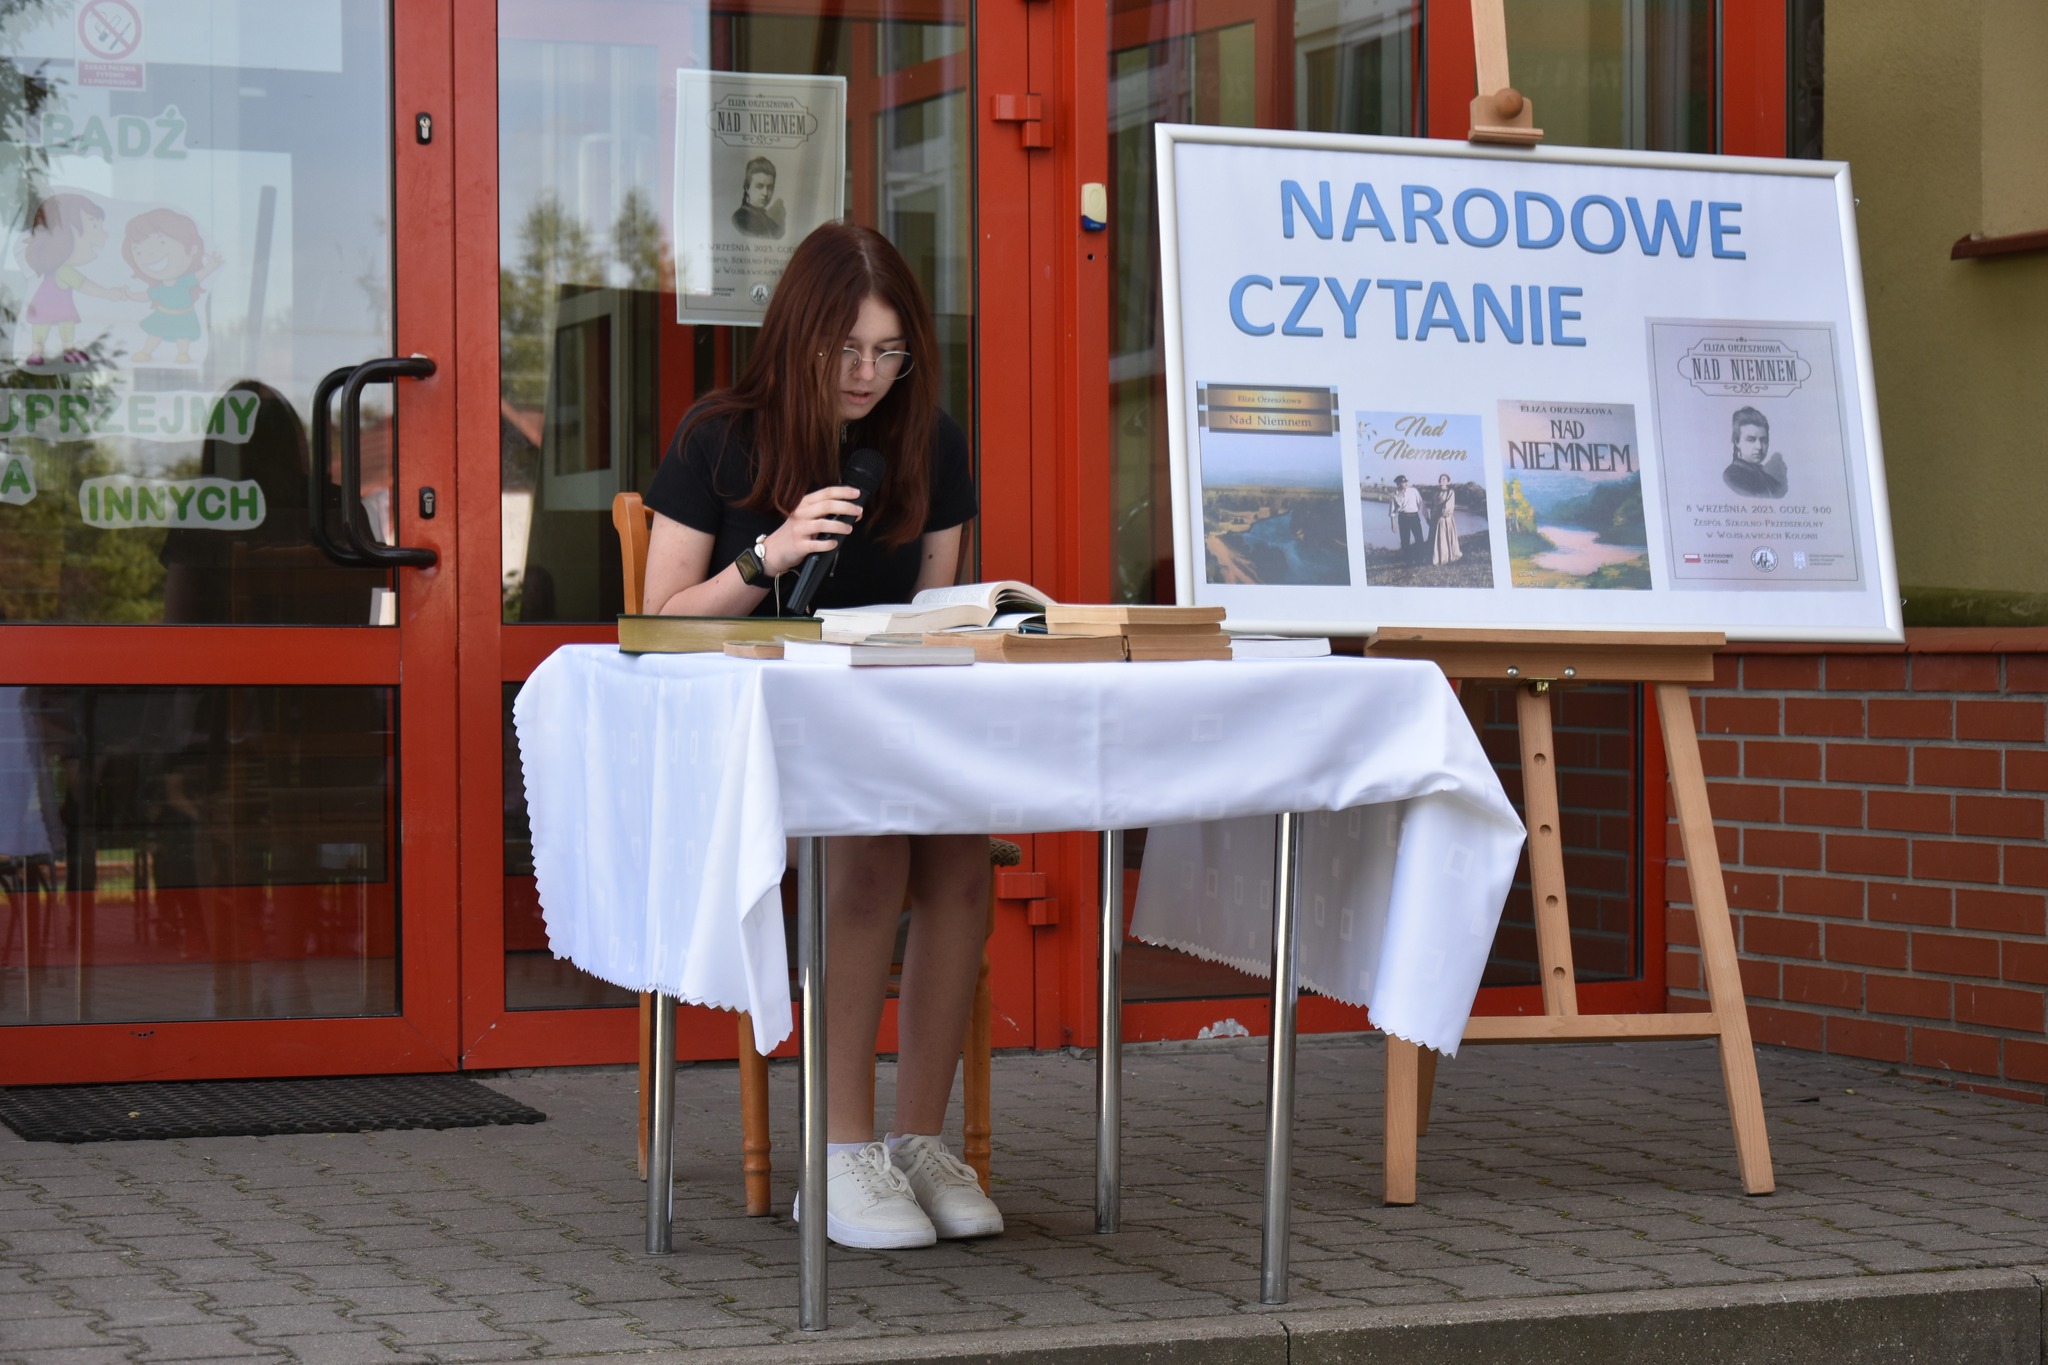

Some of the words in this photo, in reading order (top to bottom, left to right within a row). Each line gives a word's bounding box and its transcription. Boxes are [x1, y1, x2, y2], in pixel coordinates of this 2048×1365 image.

[728, 98, 747, 107] ELIZA
[748, 100, 794, 109] ORZESZKOWA
[717, 111, 741, 132] NAD
[749, 112, 806, 135] NIEMNEM
[43, 108, 187, 164] BĄDŹ
[1280, 179, 1747, 260] NARODOWE
[1228, 274, 1587, 347] CZYTANIE
[1703, 343, 1726, 352] ELIZA
[1727, 344, 1782, 353] ORZESZKOWA
[1691, 358, 1721, 380] NAD
[1730, 359, 1798, 382] NIEMNEM
[1238, 395, 1255, 403] Eliza
[1257, 396, 1302, 404] Orzeszkowa
[1520, 405, 1547, 414] ELIZA
[1550, 406, 1613, 416] ORZESZKOWA
[1229, 414, 1252, 425] Nad
[1257, 416, 1312, 428] Niemnem
[1394, 415, 1448, 438] Nad
[1550, 419, 1585, 440] NAD
[1373, 438, 1468, 462] Niemnem
[1508, 440, 1634, 473] NIEMNEM
[88, 486, 258, 522] INNYCH
[1696, 503, 1748, 514] WRZEŚNIA
